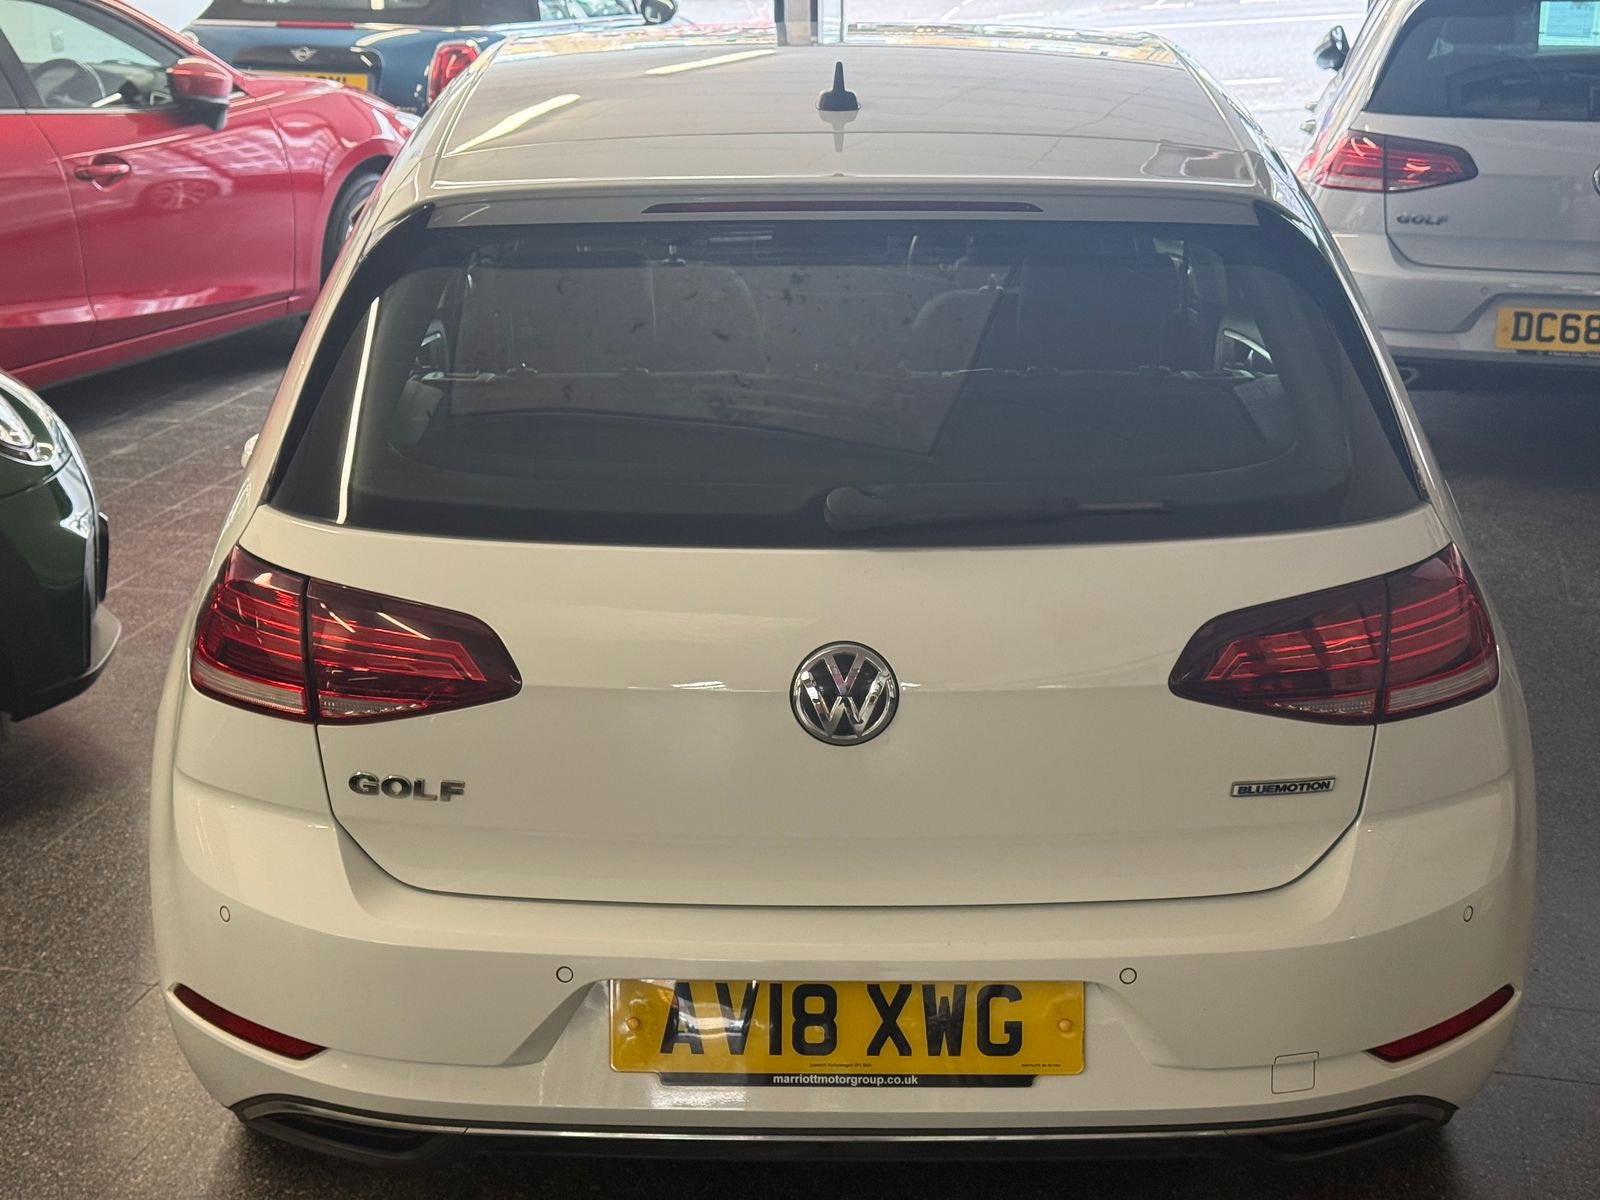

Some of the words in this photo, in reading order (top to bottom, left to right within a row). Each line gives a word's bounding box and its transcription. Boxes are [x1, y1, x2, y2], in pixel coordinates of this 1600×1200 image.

[1511, 311, 1600, 344] DC68
[348, 771, 466, 802] GOLF
[1237, 780, 1331, 795] BLUEMOTION
[660, 982, 837, 1056] AV18
[866, 983, 1023, 1057] XWG
[772, 1073, 919, 1087] marriottmotorgroup.co.uk
